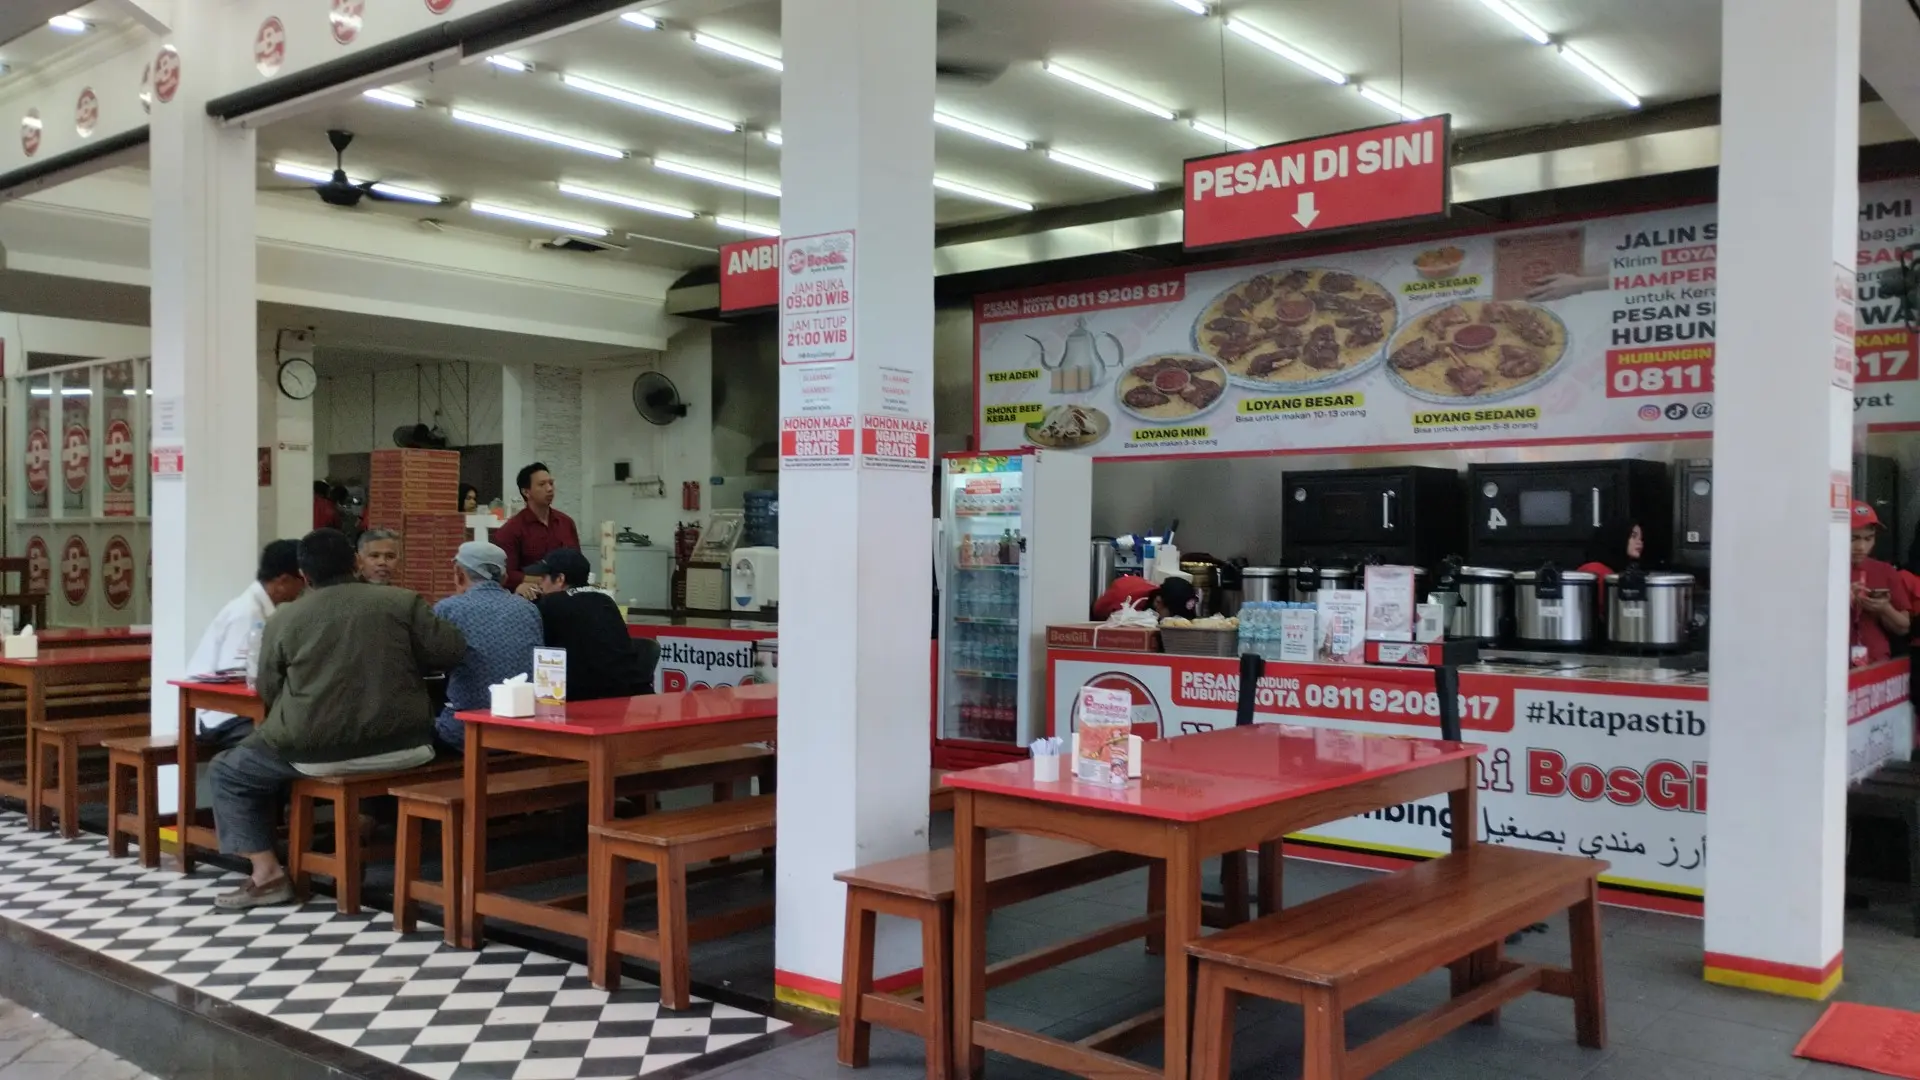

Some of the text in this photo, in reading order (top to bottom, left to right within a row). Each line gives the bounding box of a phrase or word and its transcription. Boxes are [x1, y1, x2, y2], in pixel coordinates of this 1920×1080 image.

[1193, 131, 1434, 200] PESAN DI SINI
[1616, 226, 1696, 250] JALIN
[1613, 255, 1658, 269] Kirim
[1861, 224, 1914, 242] bagai
[728, 244, 778, 275] AMBI
[1404, 276, 1478, 292] ACAR SEGAR
[1614, 267, 1716, 290] HAMPER
[791, 279, 845, 295] JAM BUKA
[1057, 281, 1180, 309] 0811 9208 817
[786, 290, 849, 309] 09:00 WIB
[1625, 290, 1676, 305] untuk
[1023, 302, 1056, 314] KOTA
[1613, 303, 1690, 324] PESAN
[788, 316, 847, 332] JAM TUTUP
[787, 329, 847, 347] 21:00 WIB
[1612, 320, 1716, 345] HUBUN
[1618, 347, 1712, 365] HUBUNGIN
[989, 370, 1039, 382] TEH ADENI
[1614, 364, 1702, 393] 0811
[987, 404, 1042, 415] SMOKE BEEF
[1246, 395, 1354, 412] LOYANG BESAR
[784, 417, 853, 430] MOHON MAAF
[864, 416, 928, 432] MOHON MAAF
[987, 414, 1016, 422] KEBAB
[1235, 415, 1254, 423] Bisa
[1255, 414, 1280, 422] untuk
[1313, 410, 1338, 419] 10-13
[1340, 409, 1366, 417] orang
[1415, 408, 1537, 424] LOYANG SEDANG
[1136, 427, 1206, 440] LOYANG MINI
[1433, 425, 1459, 433] untuk
[1460, 424, 1491, 432] makan
[1511, 421, 1539, 430] orang
[795, 430, 839, 442] NGAMEN
[875, 430, 916, 444] NGAMEN
[795, 442, 840, 456] GRATIS
[876, 442, 917, 458] GRATIS
[1181, 671, 1240, 690] PESAN
[1305, 684, 1364, 711] 0811
[1369, 688, 1441, 717] 9208
